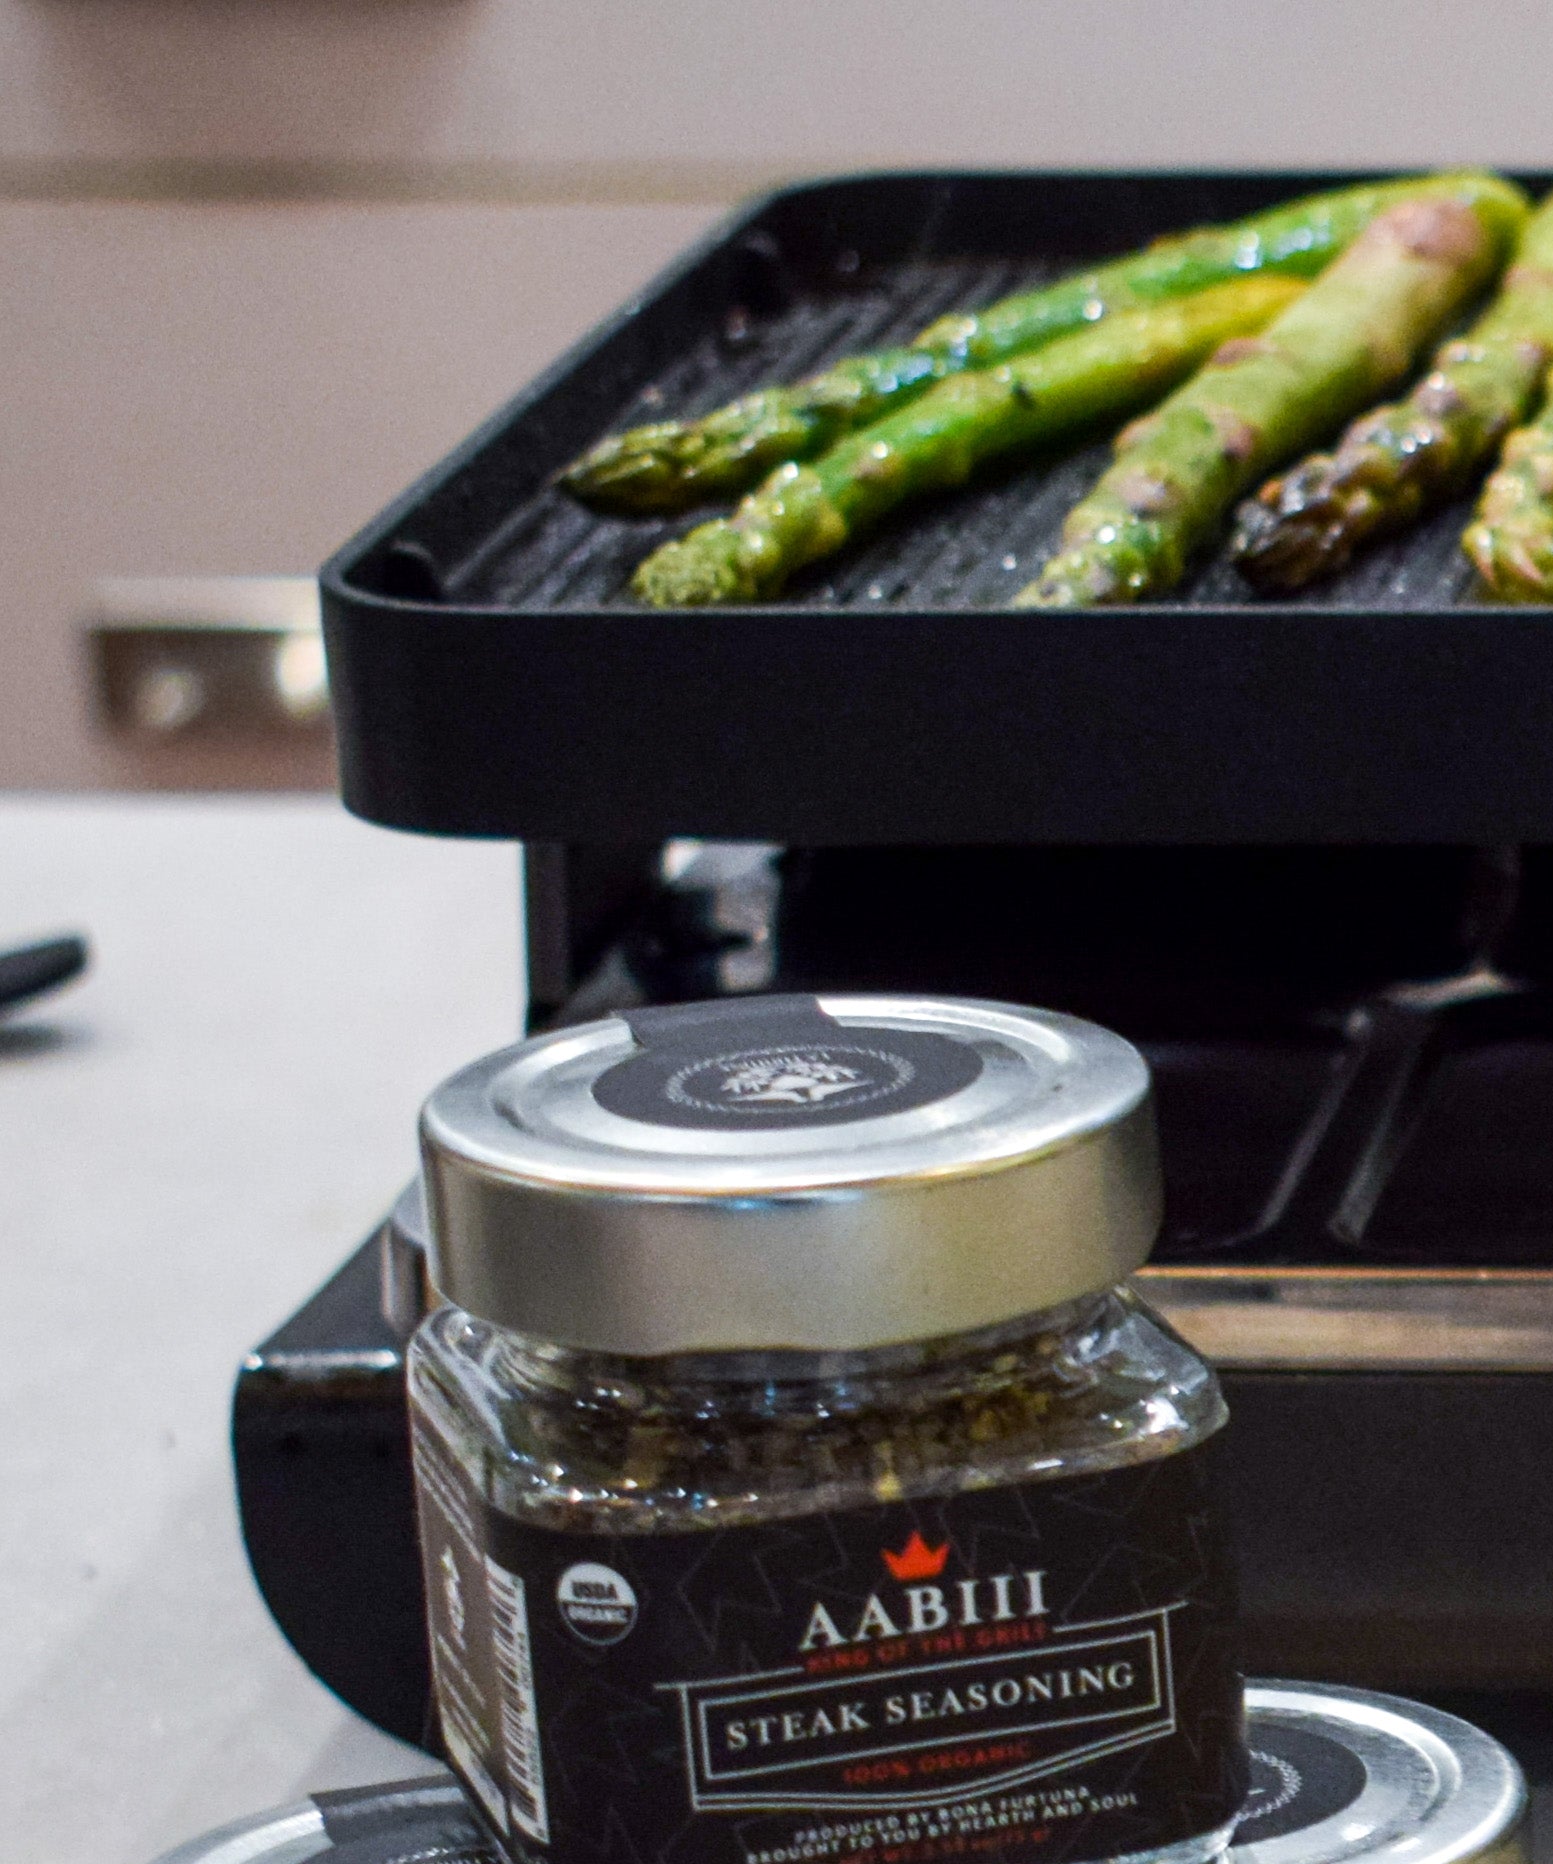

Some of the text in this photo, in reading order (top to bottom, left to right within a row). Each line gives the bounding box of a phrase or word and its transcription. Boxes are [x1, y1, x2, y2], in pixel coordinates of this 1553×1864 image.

[571, 1581, 618, 1600] USDA
[799, 1570, 1049, 1650] AABIII
[725, 1661, 1135, 1752] STEAK SEASONING
